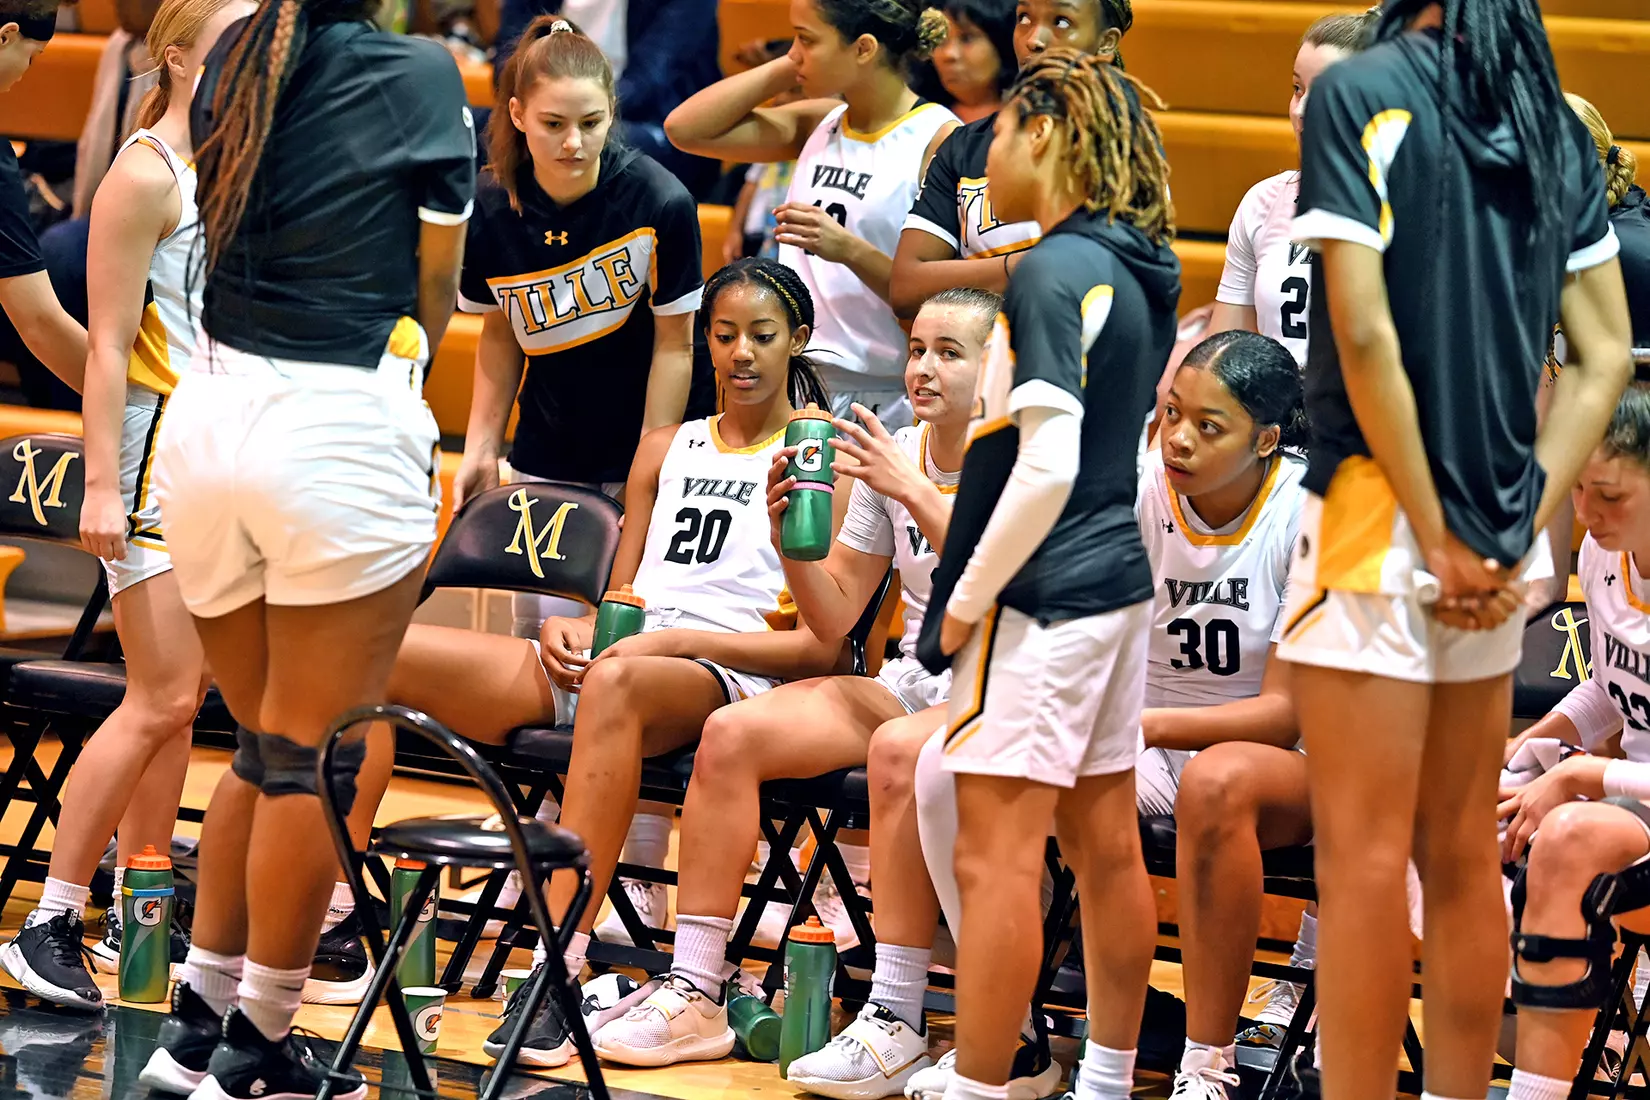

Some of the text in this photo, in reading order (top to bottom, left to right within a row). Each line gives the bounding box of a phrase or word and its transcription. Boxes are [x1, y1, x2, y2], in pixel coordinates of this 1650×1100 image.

[811, 164, 873, 201] VILLE
[794, 437, 823, 472] G
[682, 476, 758, 506] VILLE
[663, 506, 733, 565] 20
[1164, 577, 1250, 612] VILLE
[1166, 617, 1241, 676] 30
[132, 896, 163, 927] G
